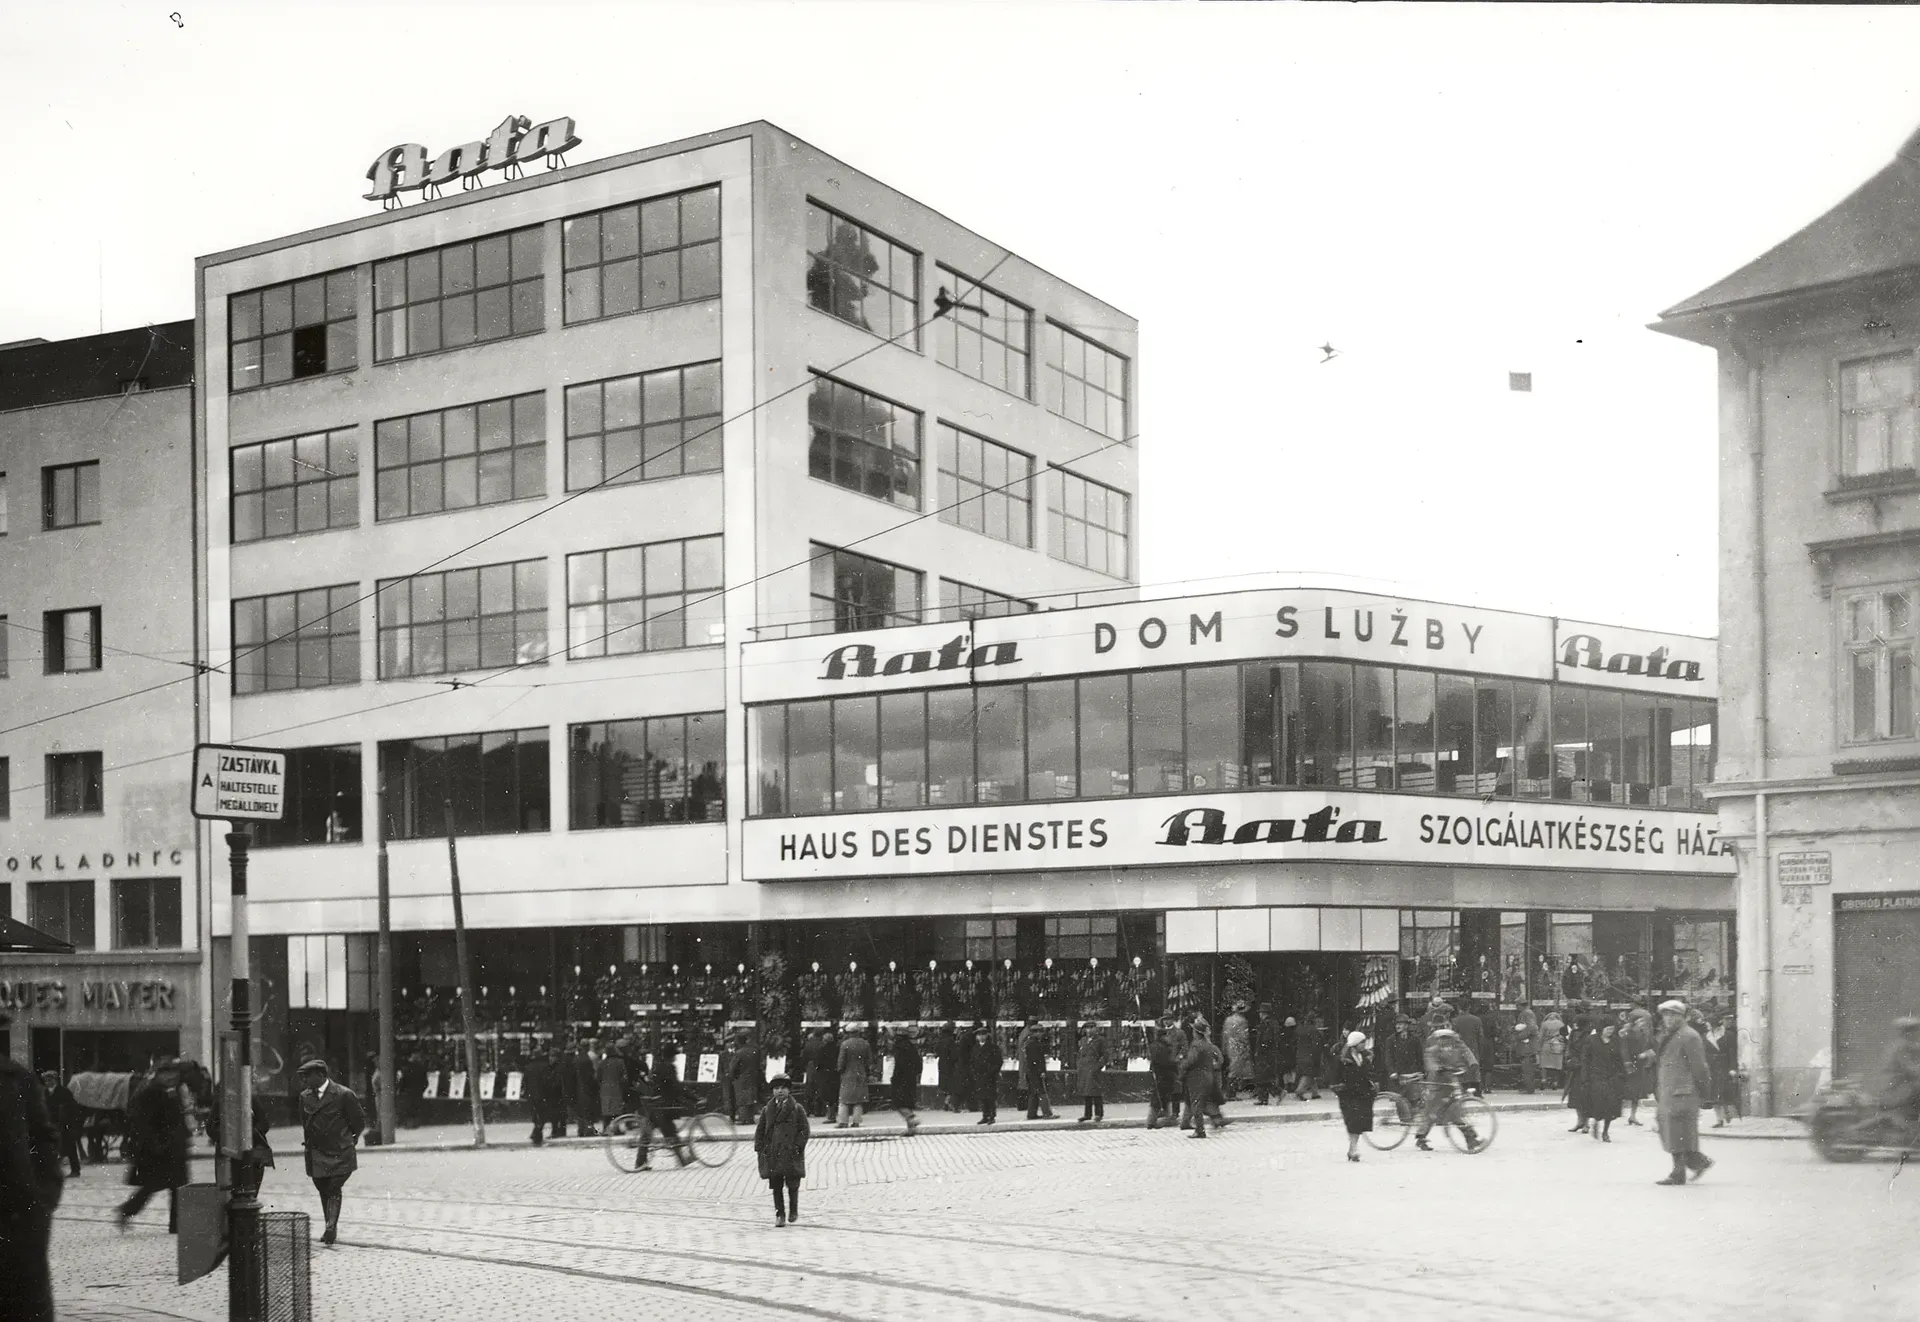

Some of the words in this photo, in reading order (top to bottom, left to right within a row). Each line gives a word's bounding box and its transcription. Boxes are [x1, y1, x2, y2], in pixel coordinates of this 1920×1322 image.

[1095, 611, 1222, 654] DOM
[1275, 606, 1484, 654] SLUŽBY
[201, 773, 213, 787] A
[780, 831, 858, 861] HAUS
[871, 827, 932, 857] DES
[948, 818, 1108, 853] DIENSTES
[1420, 812, 1664, 854] SZOLGÁLATKÉSZSÉG
[82, 980, 175, 1010] MAYER
